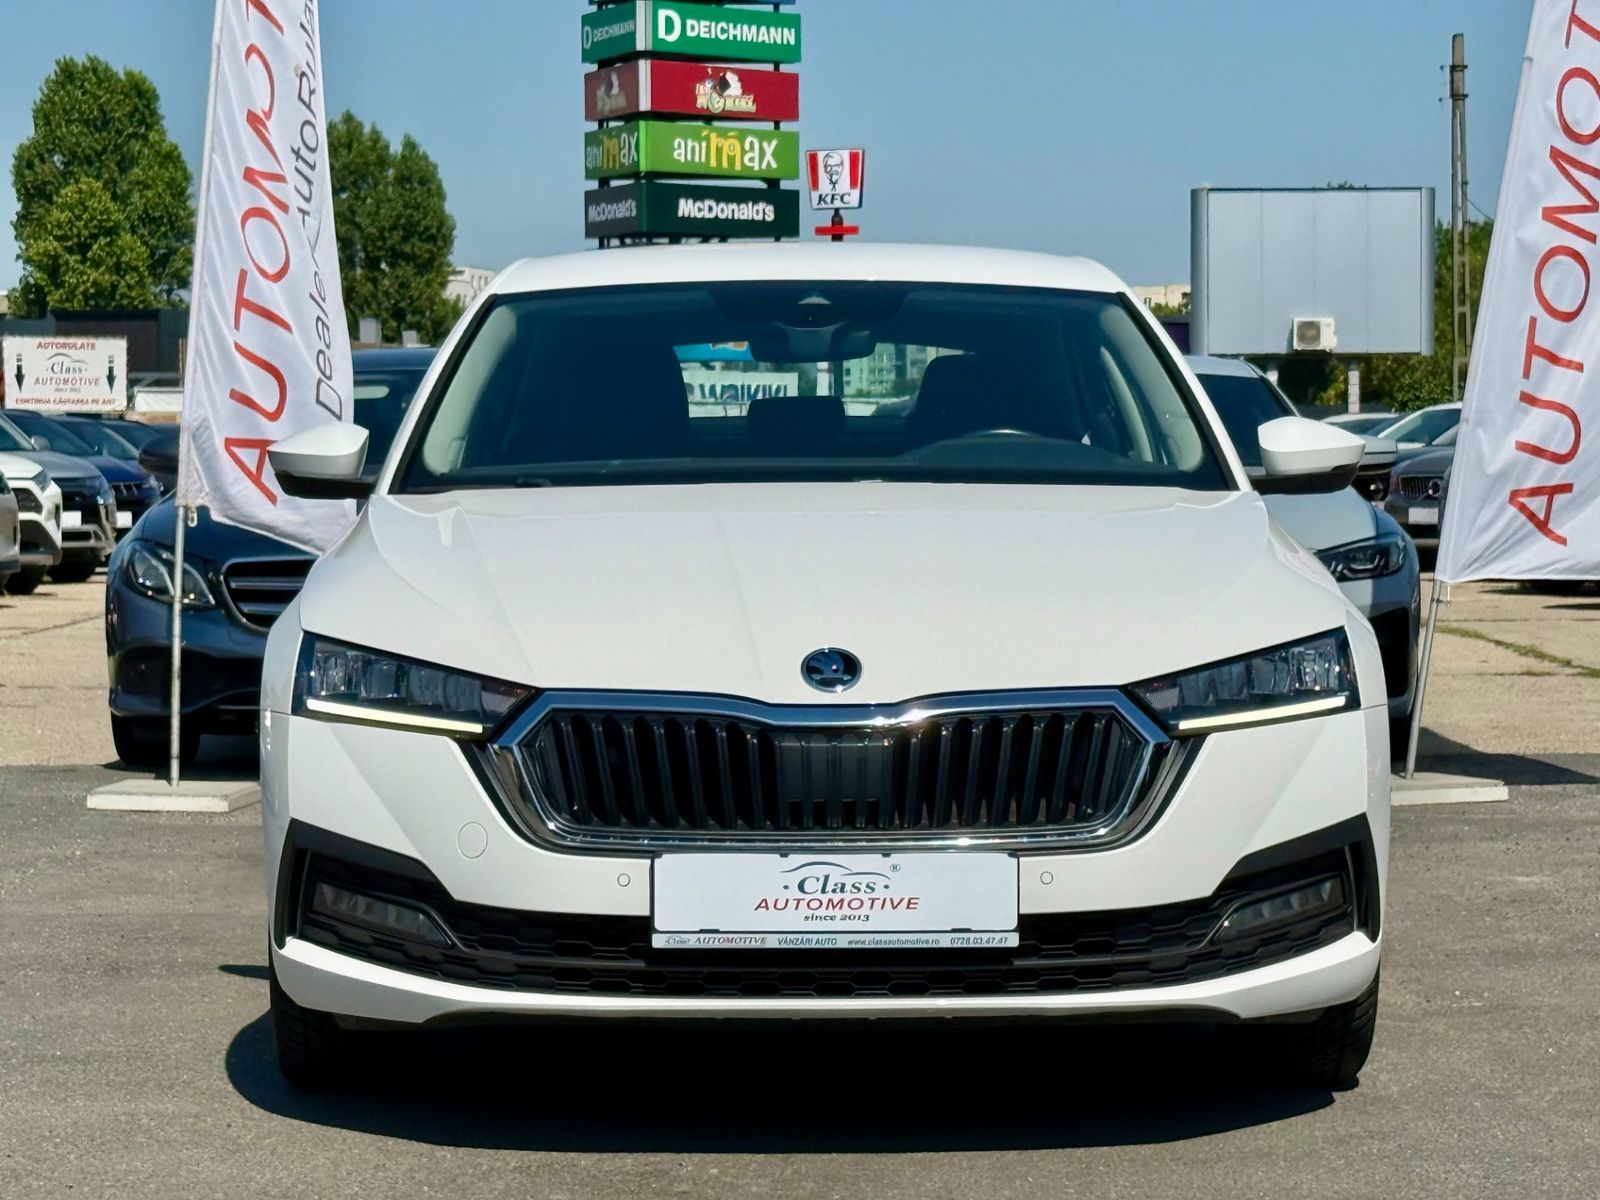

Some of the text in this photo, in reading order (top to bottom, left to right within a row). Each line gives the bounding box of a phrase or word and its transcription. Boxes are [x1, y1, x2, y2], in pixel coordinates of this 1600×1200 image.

[657, 9, 796, 46] D DEICHMANN
[586, 131, 638, 170] animax
[673, 131, 778, 171] animax
[677, 198, 775, 222] McDonald's
[817, 192, 851, 206] KFC
[587, 199, 637, 223] McDonald's
[309, 243, 342, 421] Dealer
[51, 361, 83, 375] Class
[34, 376, 101, 387] AUTOMOTIVE
[797, 873, 876, 895] Class
[754, 897, 921, 911] AUTOMOTIVE
[803, 912, 870, 922] since 2013
[694, 936, 768, 945] AUTOMOTIVE
[815, 937, 838, 946] AUTO
[847, 937, 940, 946] www.classautomotive.ro
